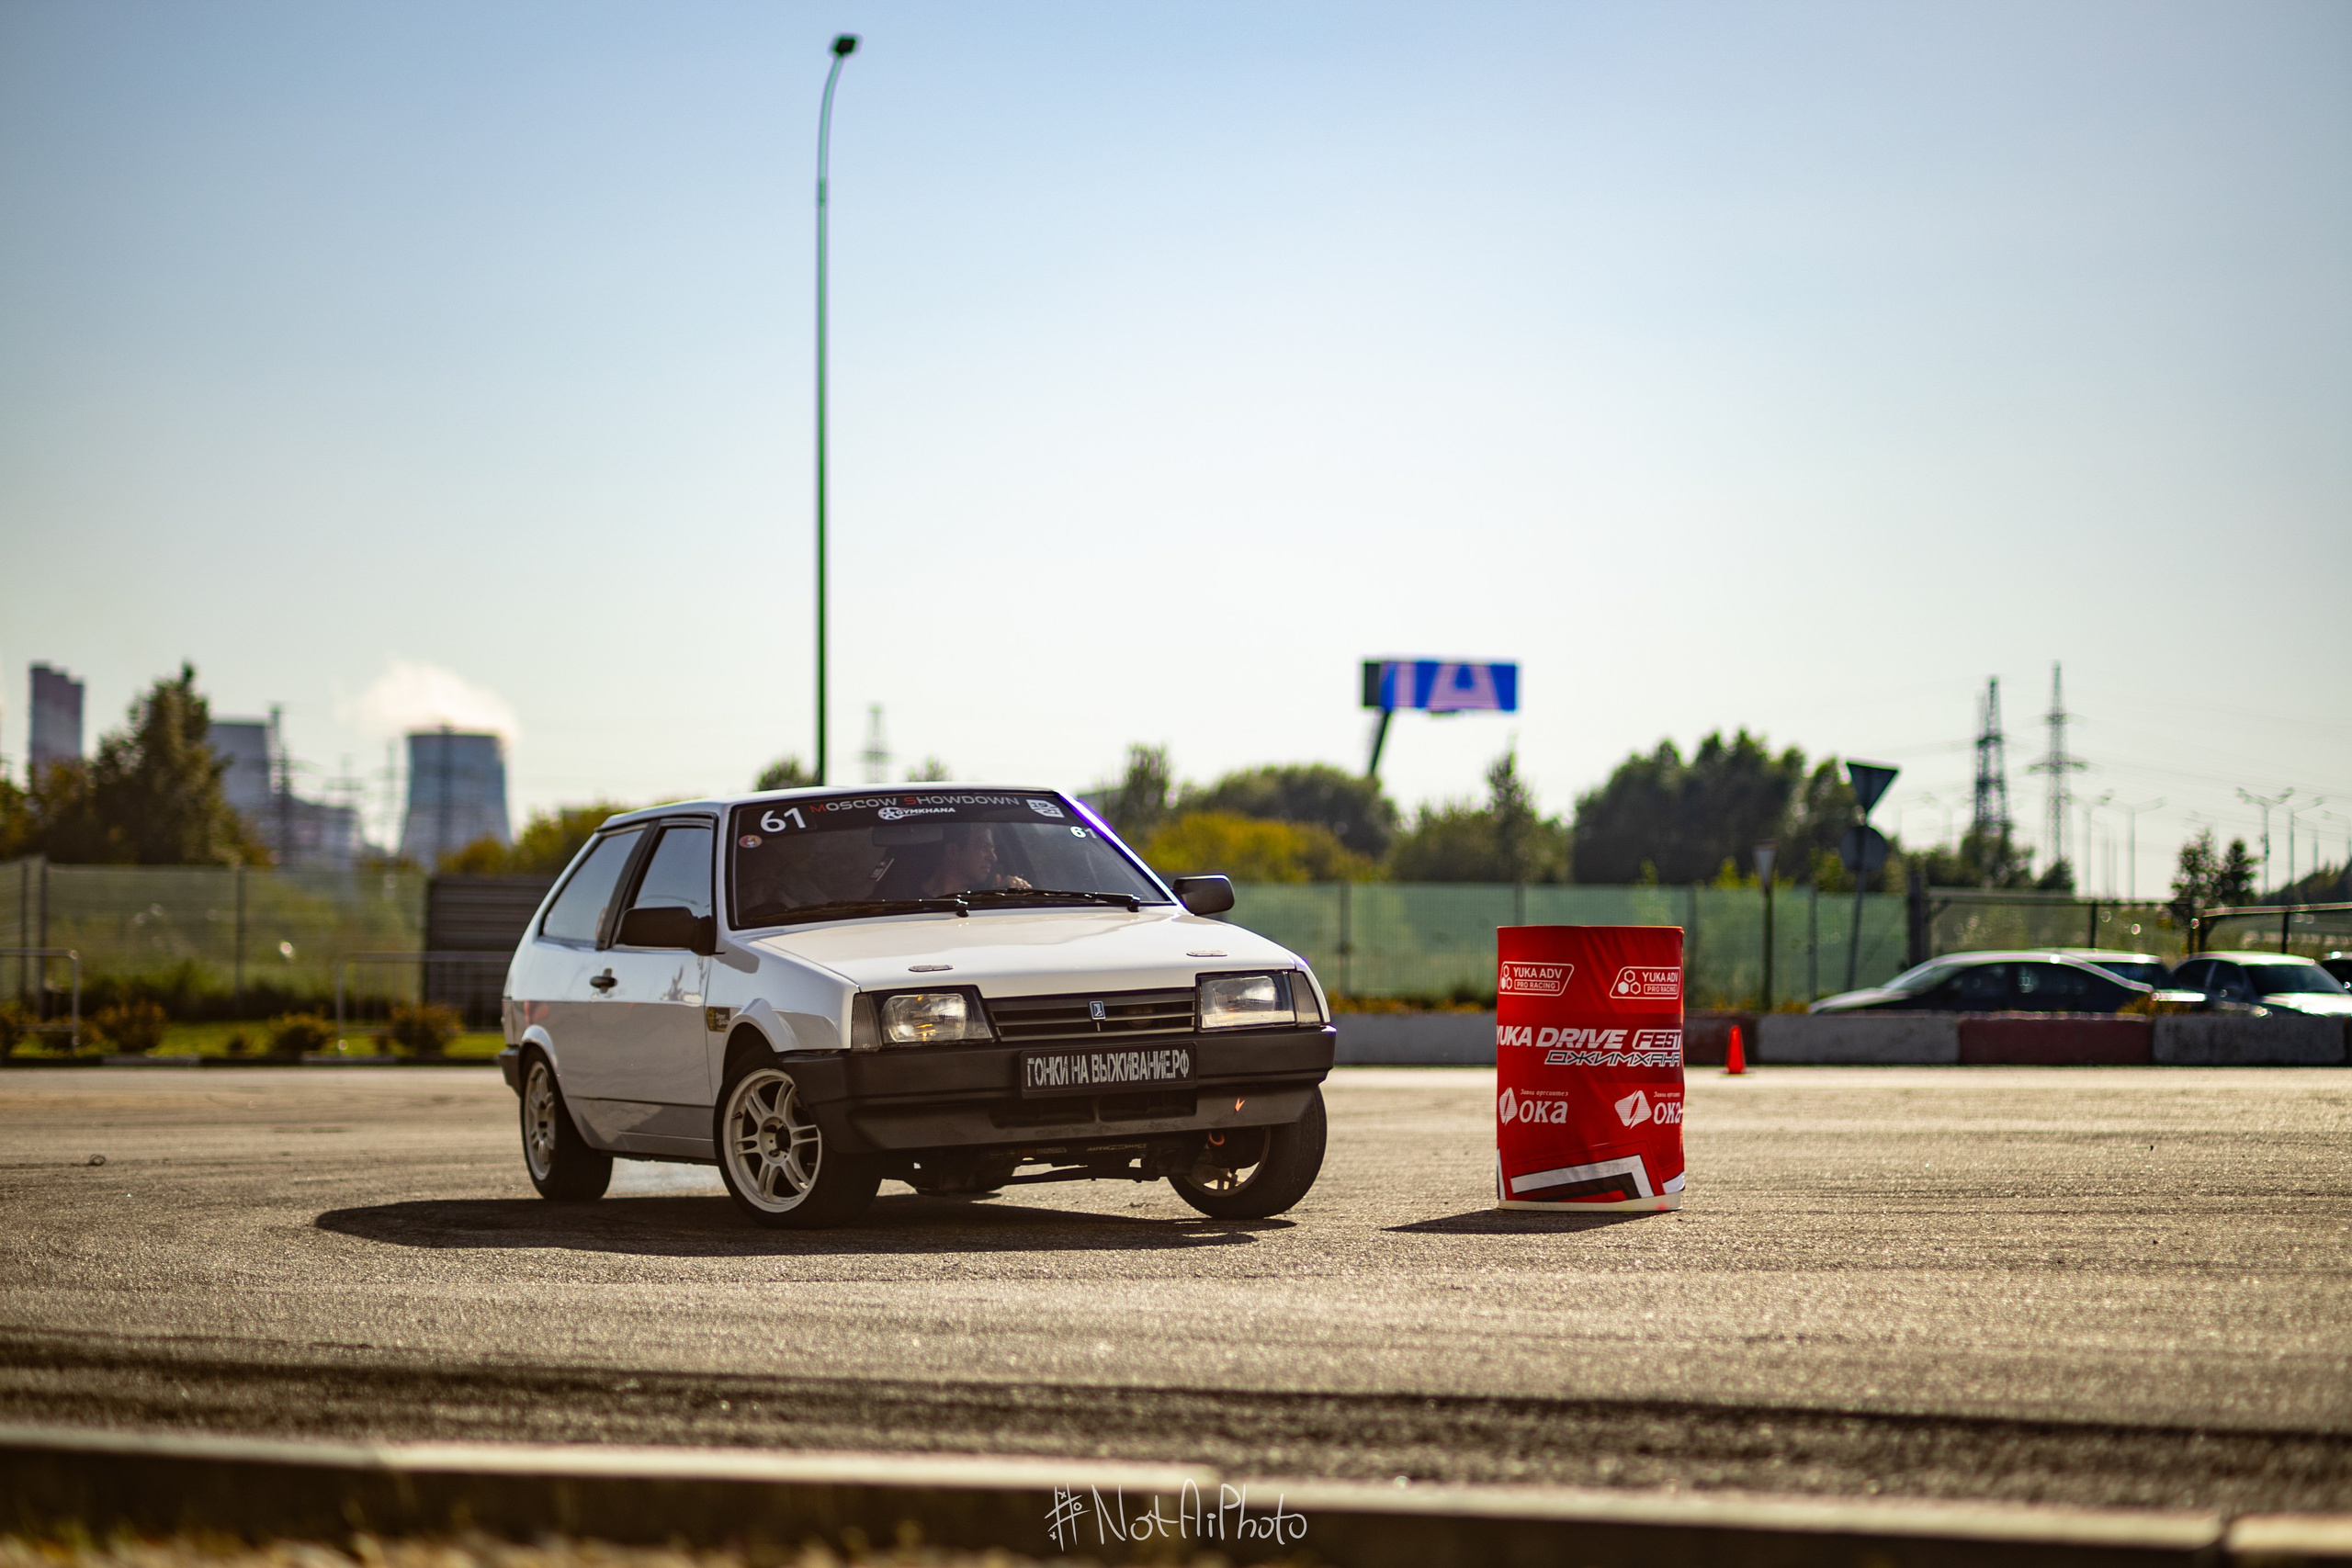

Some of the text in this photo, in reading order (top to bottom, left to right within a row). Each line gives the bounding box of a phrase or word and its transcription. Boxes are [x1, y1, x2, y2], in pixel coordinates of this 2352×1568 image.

[809, 795, 1020, 814] MOSCOW SHOWDOWN
[895, 807, 956, 816] GYMKHANA
[760, 807, 807, 833] 61
[1069, 826, 1098, 840] 61
[1513, 966, 1563, 979] YUKA ADV
[1642, 972, 1666, 983] YUKA
[1535, 1027, 1628, 1050] DRIVE
[1634, 1032, 1682, 1049] FEST
[1027, 1056, 1069, 1087] ГОНКИ
[1071, 1055, 1090, 1084] НА
